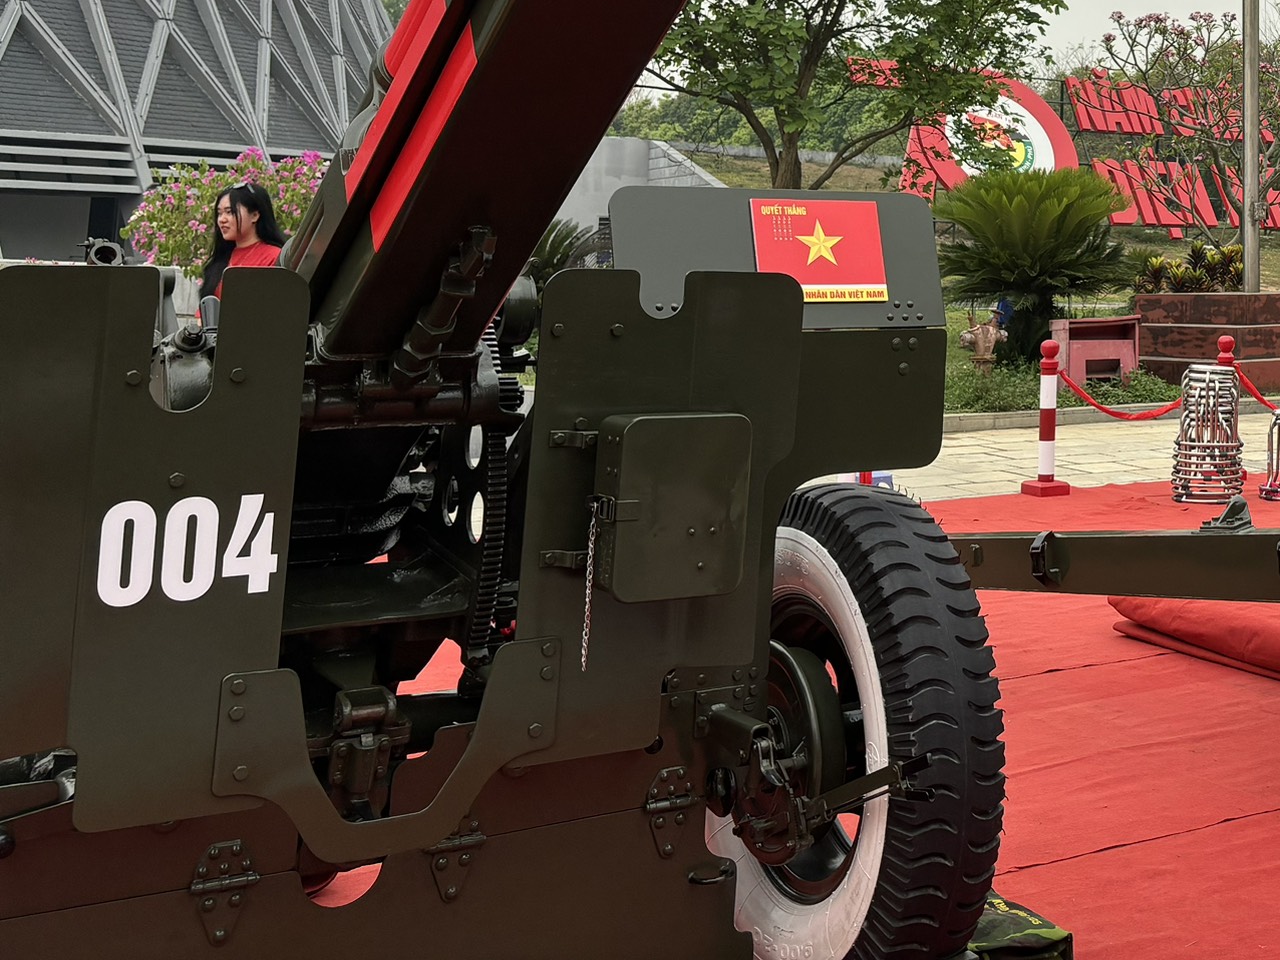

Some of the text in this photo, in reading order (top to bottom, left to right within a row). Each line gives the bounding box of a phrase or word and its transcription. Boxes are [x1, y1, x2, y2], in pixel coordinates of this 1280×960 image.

[1065, 67, 1164, 136] NĂM
[760, 203, 807, 216] QUYẾT THẮNG
[805, 289, 885, 301] NHÂN DÂN VIỆT NAM
[96, 492, 279, 608] 004
